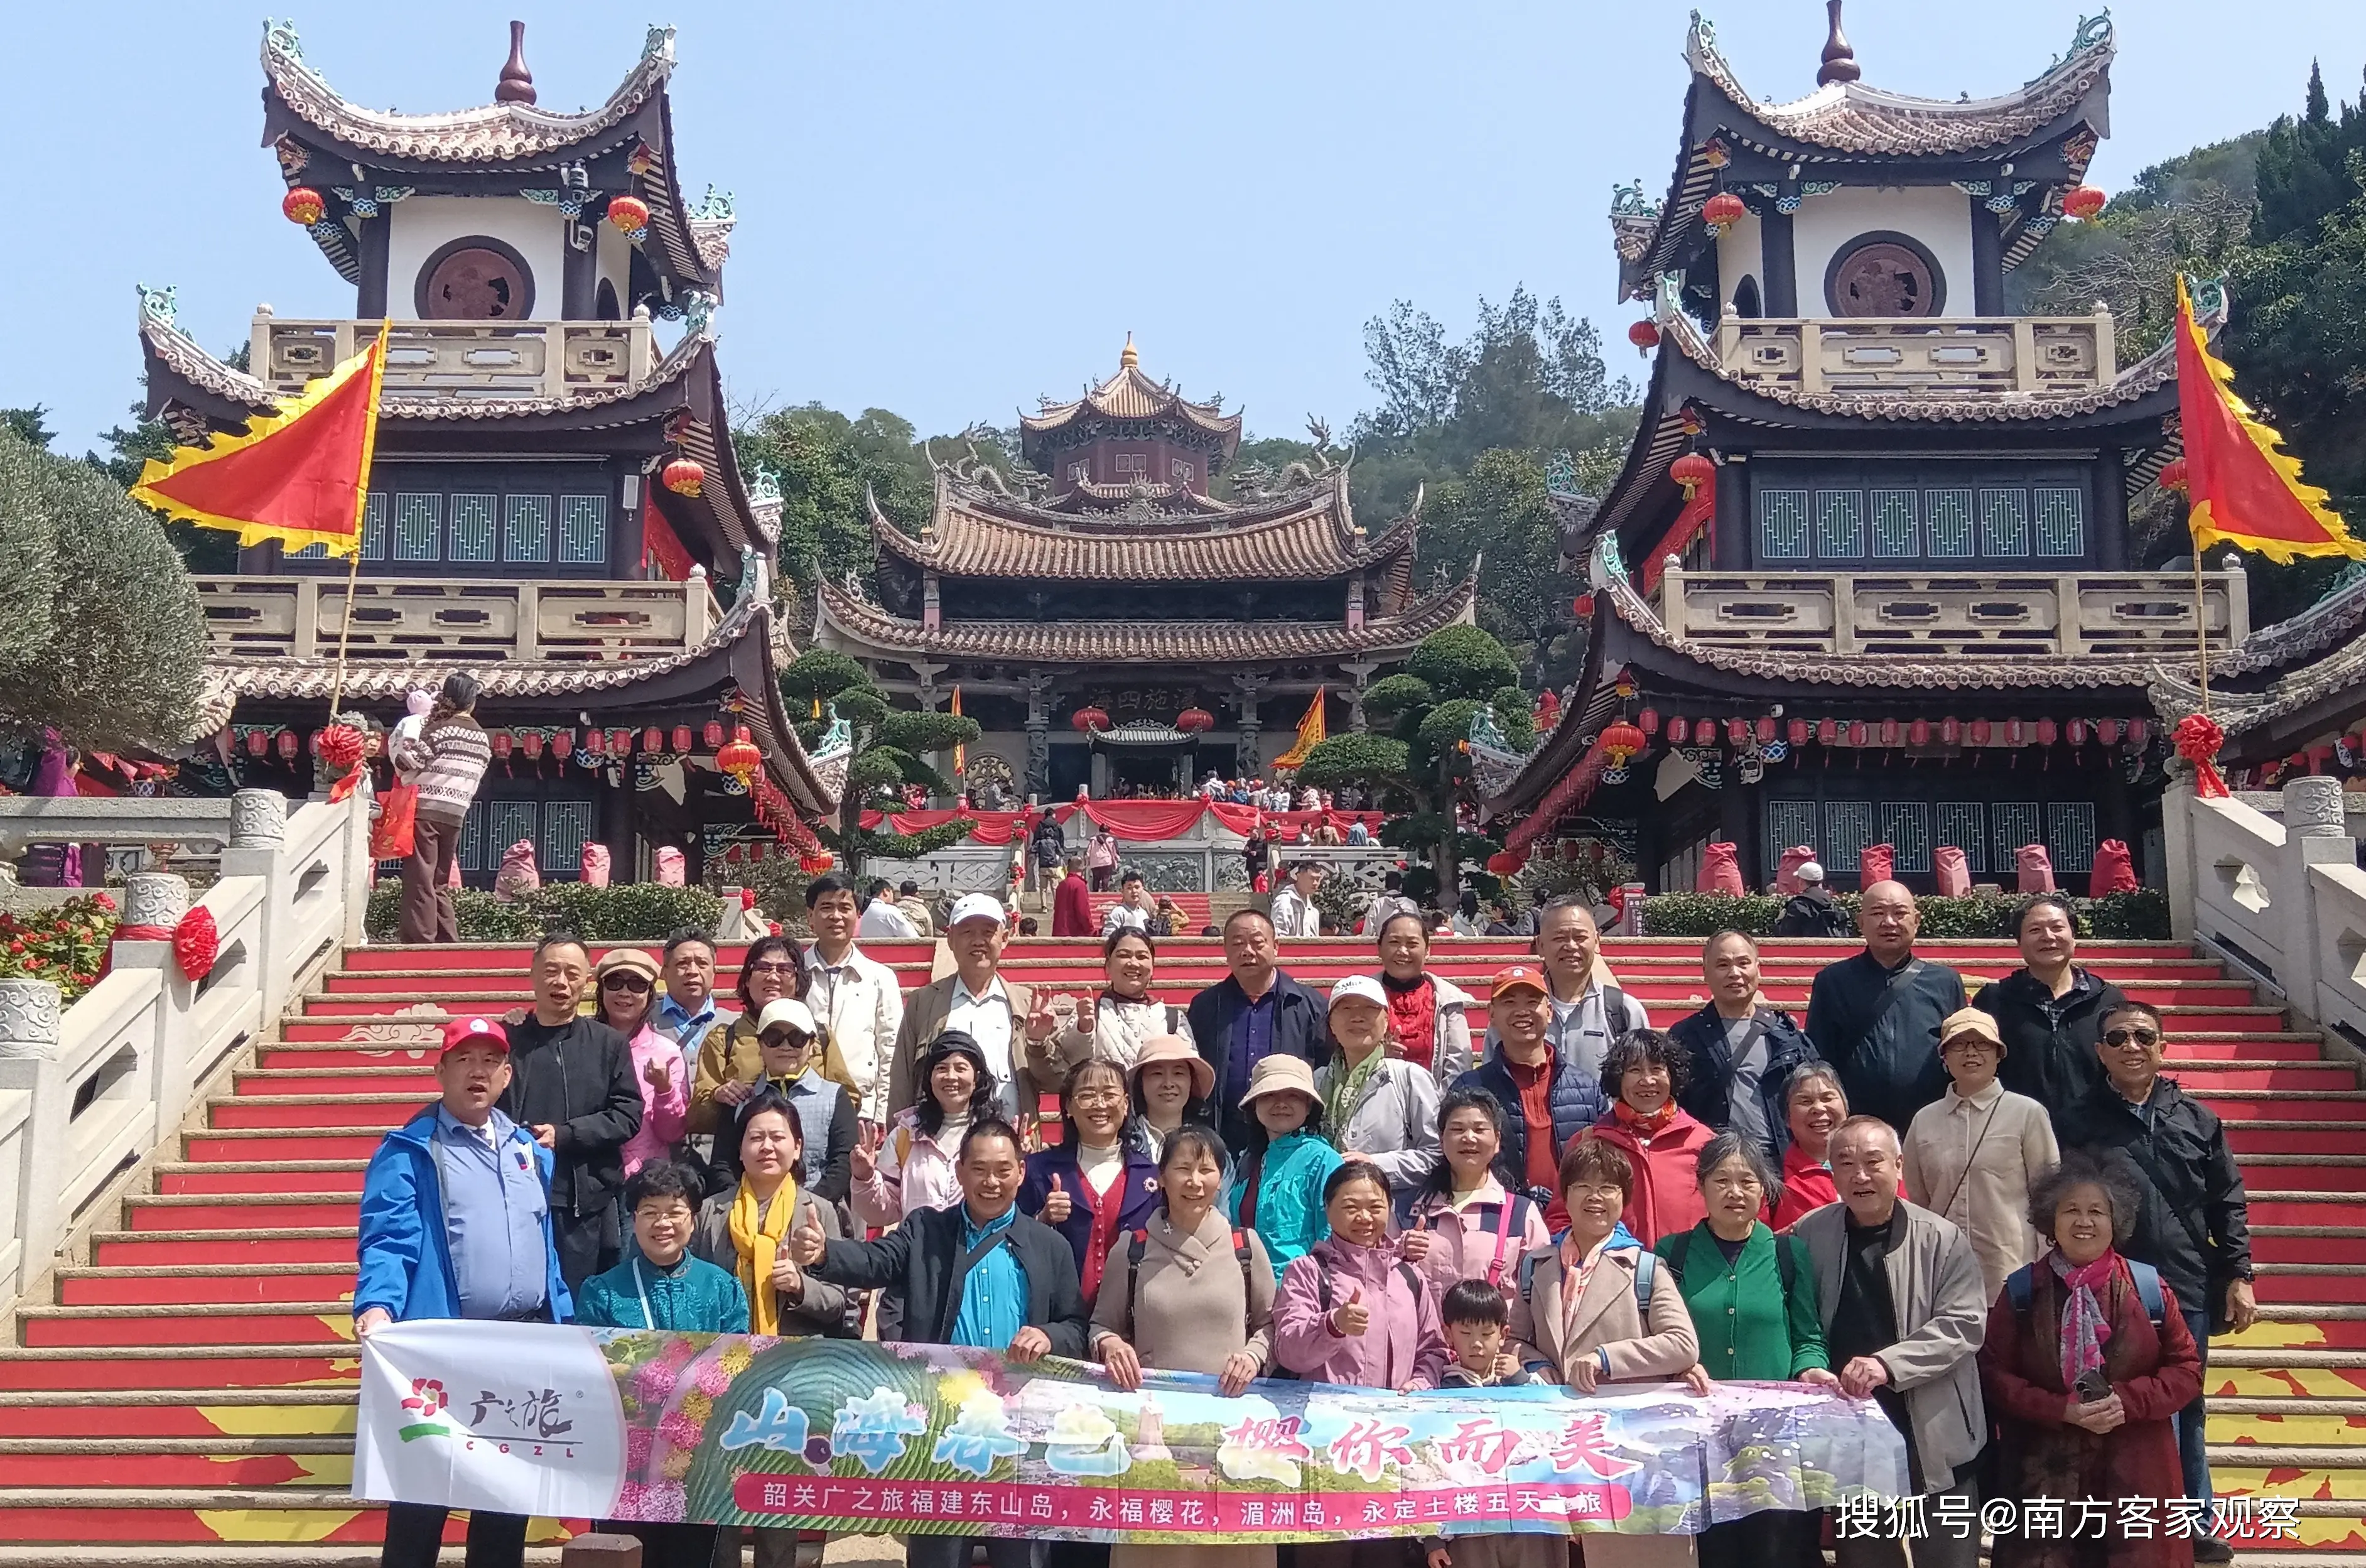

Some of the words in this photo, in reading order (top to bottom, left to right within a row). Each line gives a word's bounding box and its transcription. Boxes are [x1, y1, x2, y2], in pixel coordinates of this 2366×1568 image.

[470, 1388, 573, 1438] 广之旅
[465, 1441, 574, 1458] CGZL
